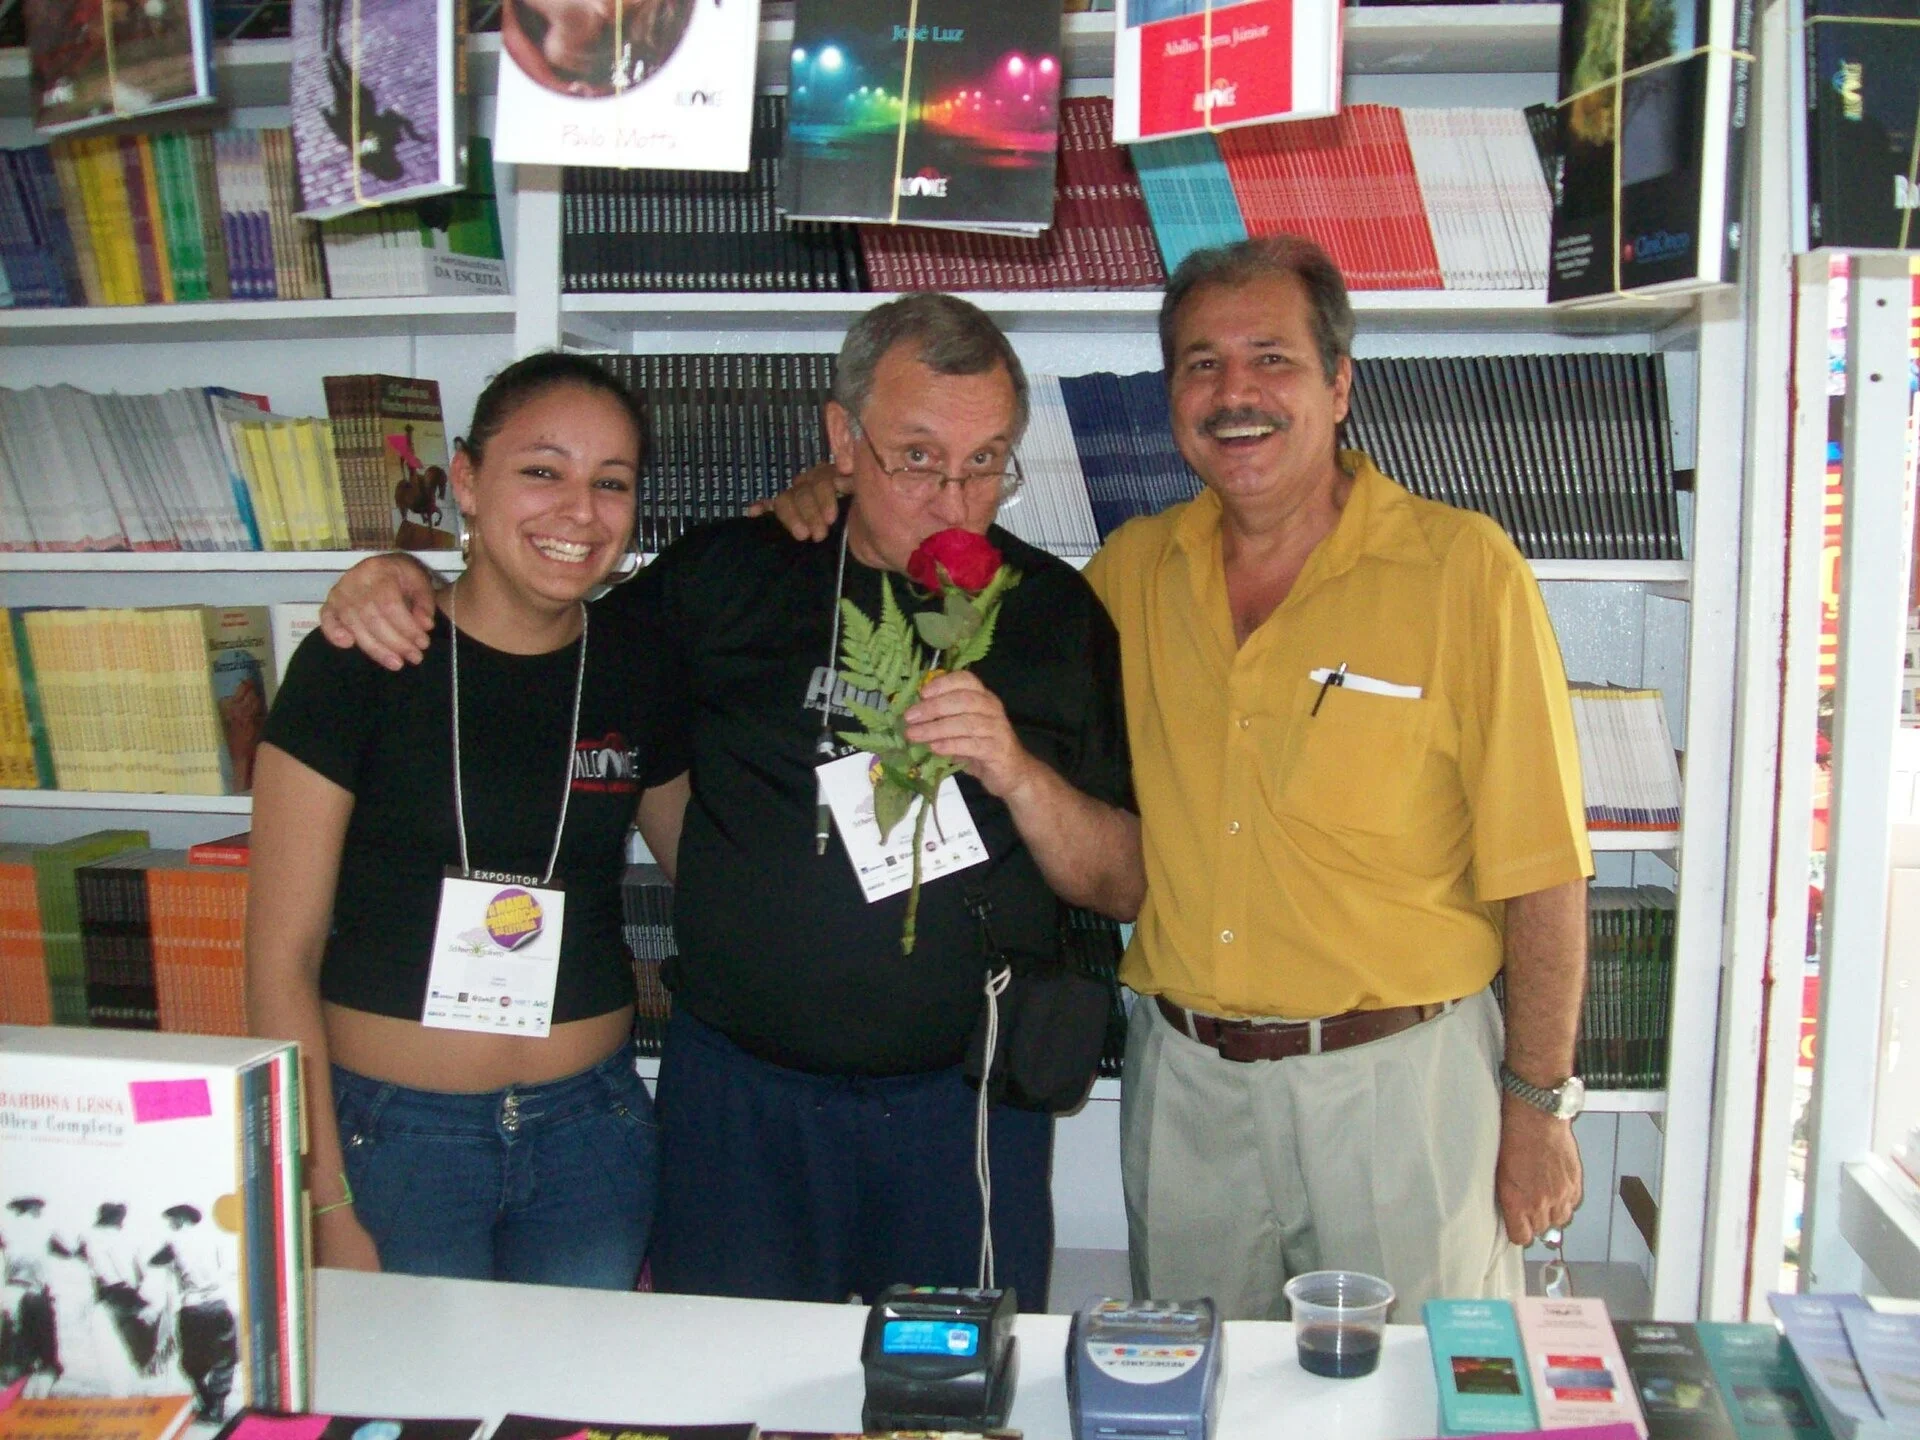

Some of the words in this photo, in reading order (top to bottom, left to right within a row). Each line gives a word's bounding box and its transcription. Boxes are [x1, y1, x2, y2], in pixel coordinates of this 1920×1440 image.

[892, 25, 930, 42] José
[932, 26, 965, 42] Luz
[434, 266, 452, 280] DA
[455, 269, 502, 287] ESCRITA
[473, 870, 539, 886] EXPOSITOR
[76, 1095, 125, 1115] LESSA
